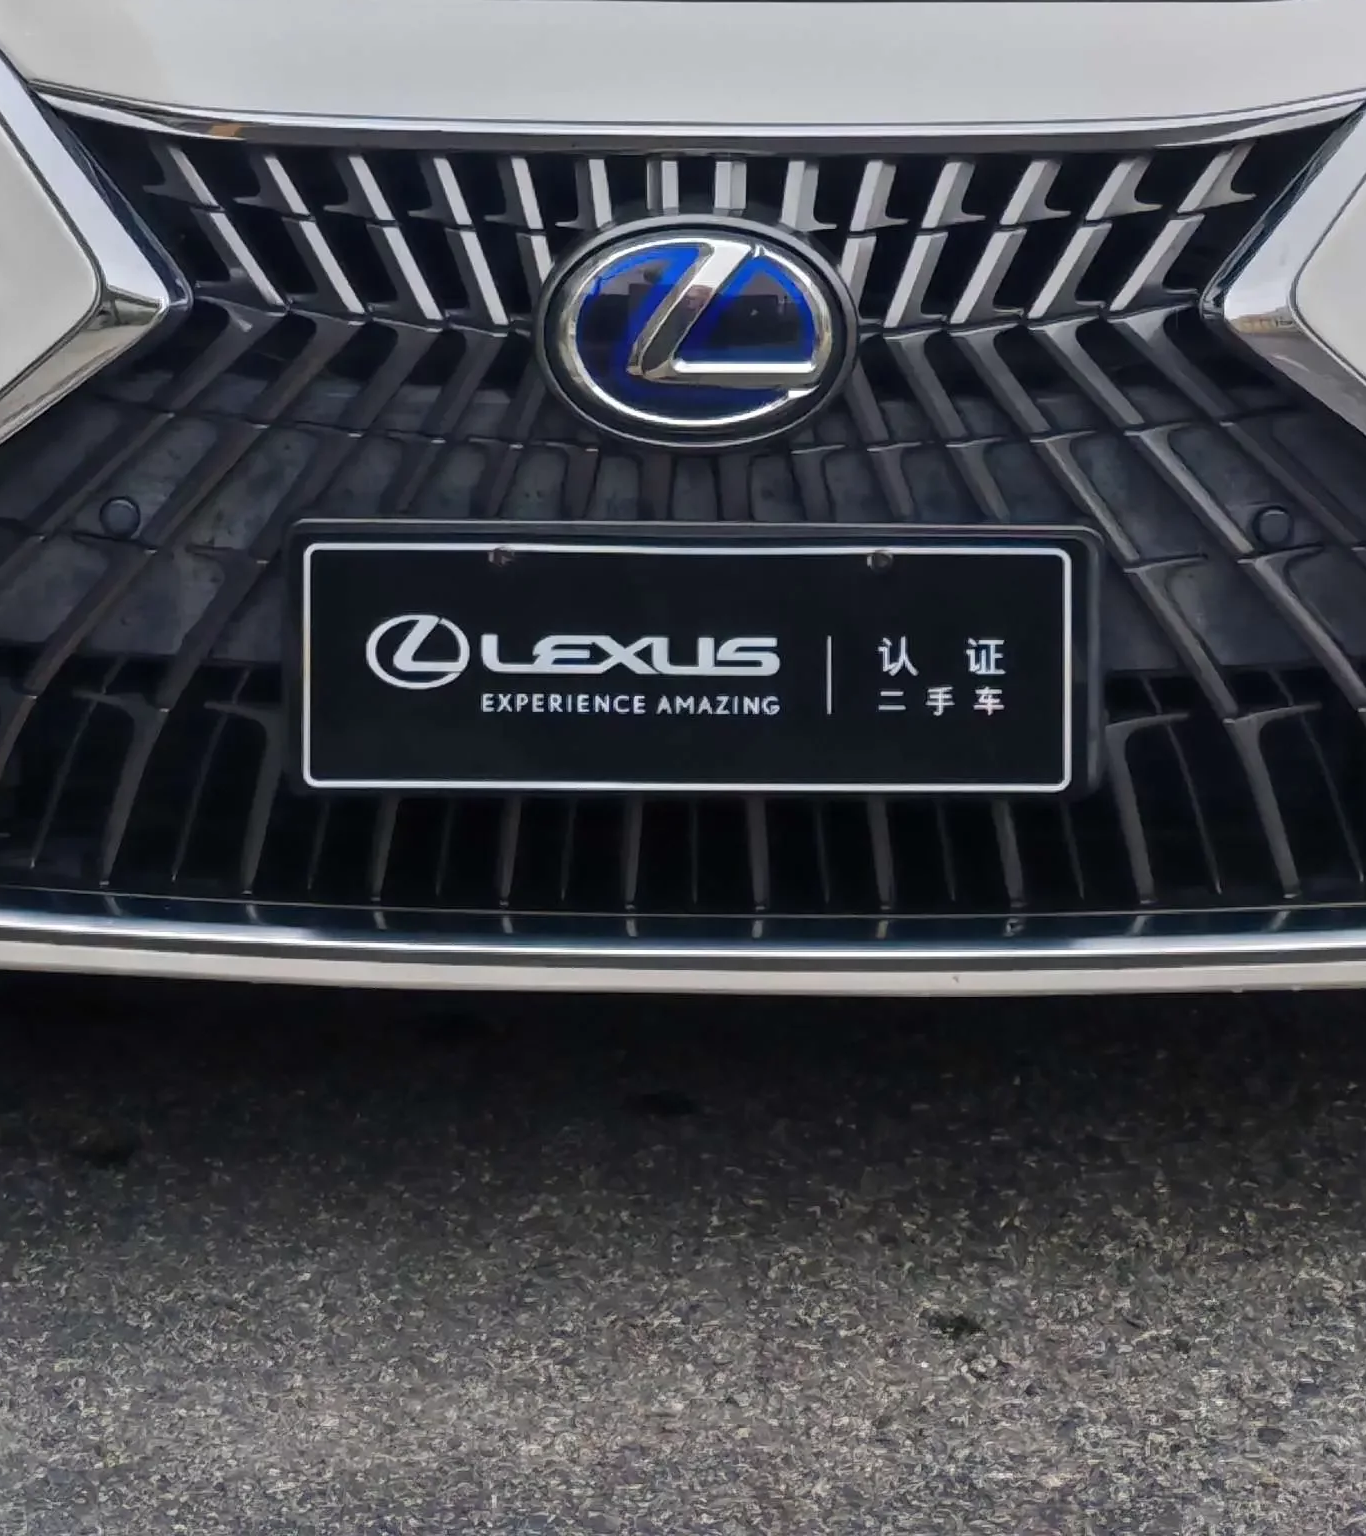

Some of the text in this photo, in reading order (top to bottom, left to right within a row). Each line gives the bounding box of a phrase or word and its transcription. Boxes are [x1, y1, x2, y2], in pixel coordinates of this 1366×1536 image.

[480, 633, 781, 677] LEXUS
[877, 635, 1007, 677] 认证
[480, 693, 781, 716] EXPERIENCE AMAZING
[878, 686, 1006, 717] 二手车
